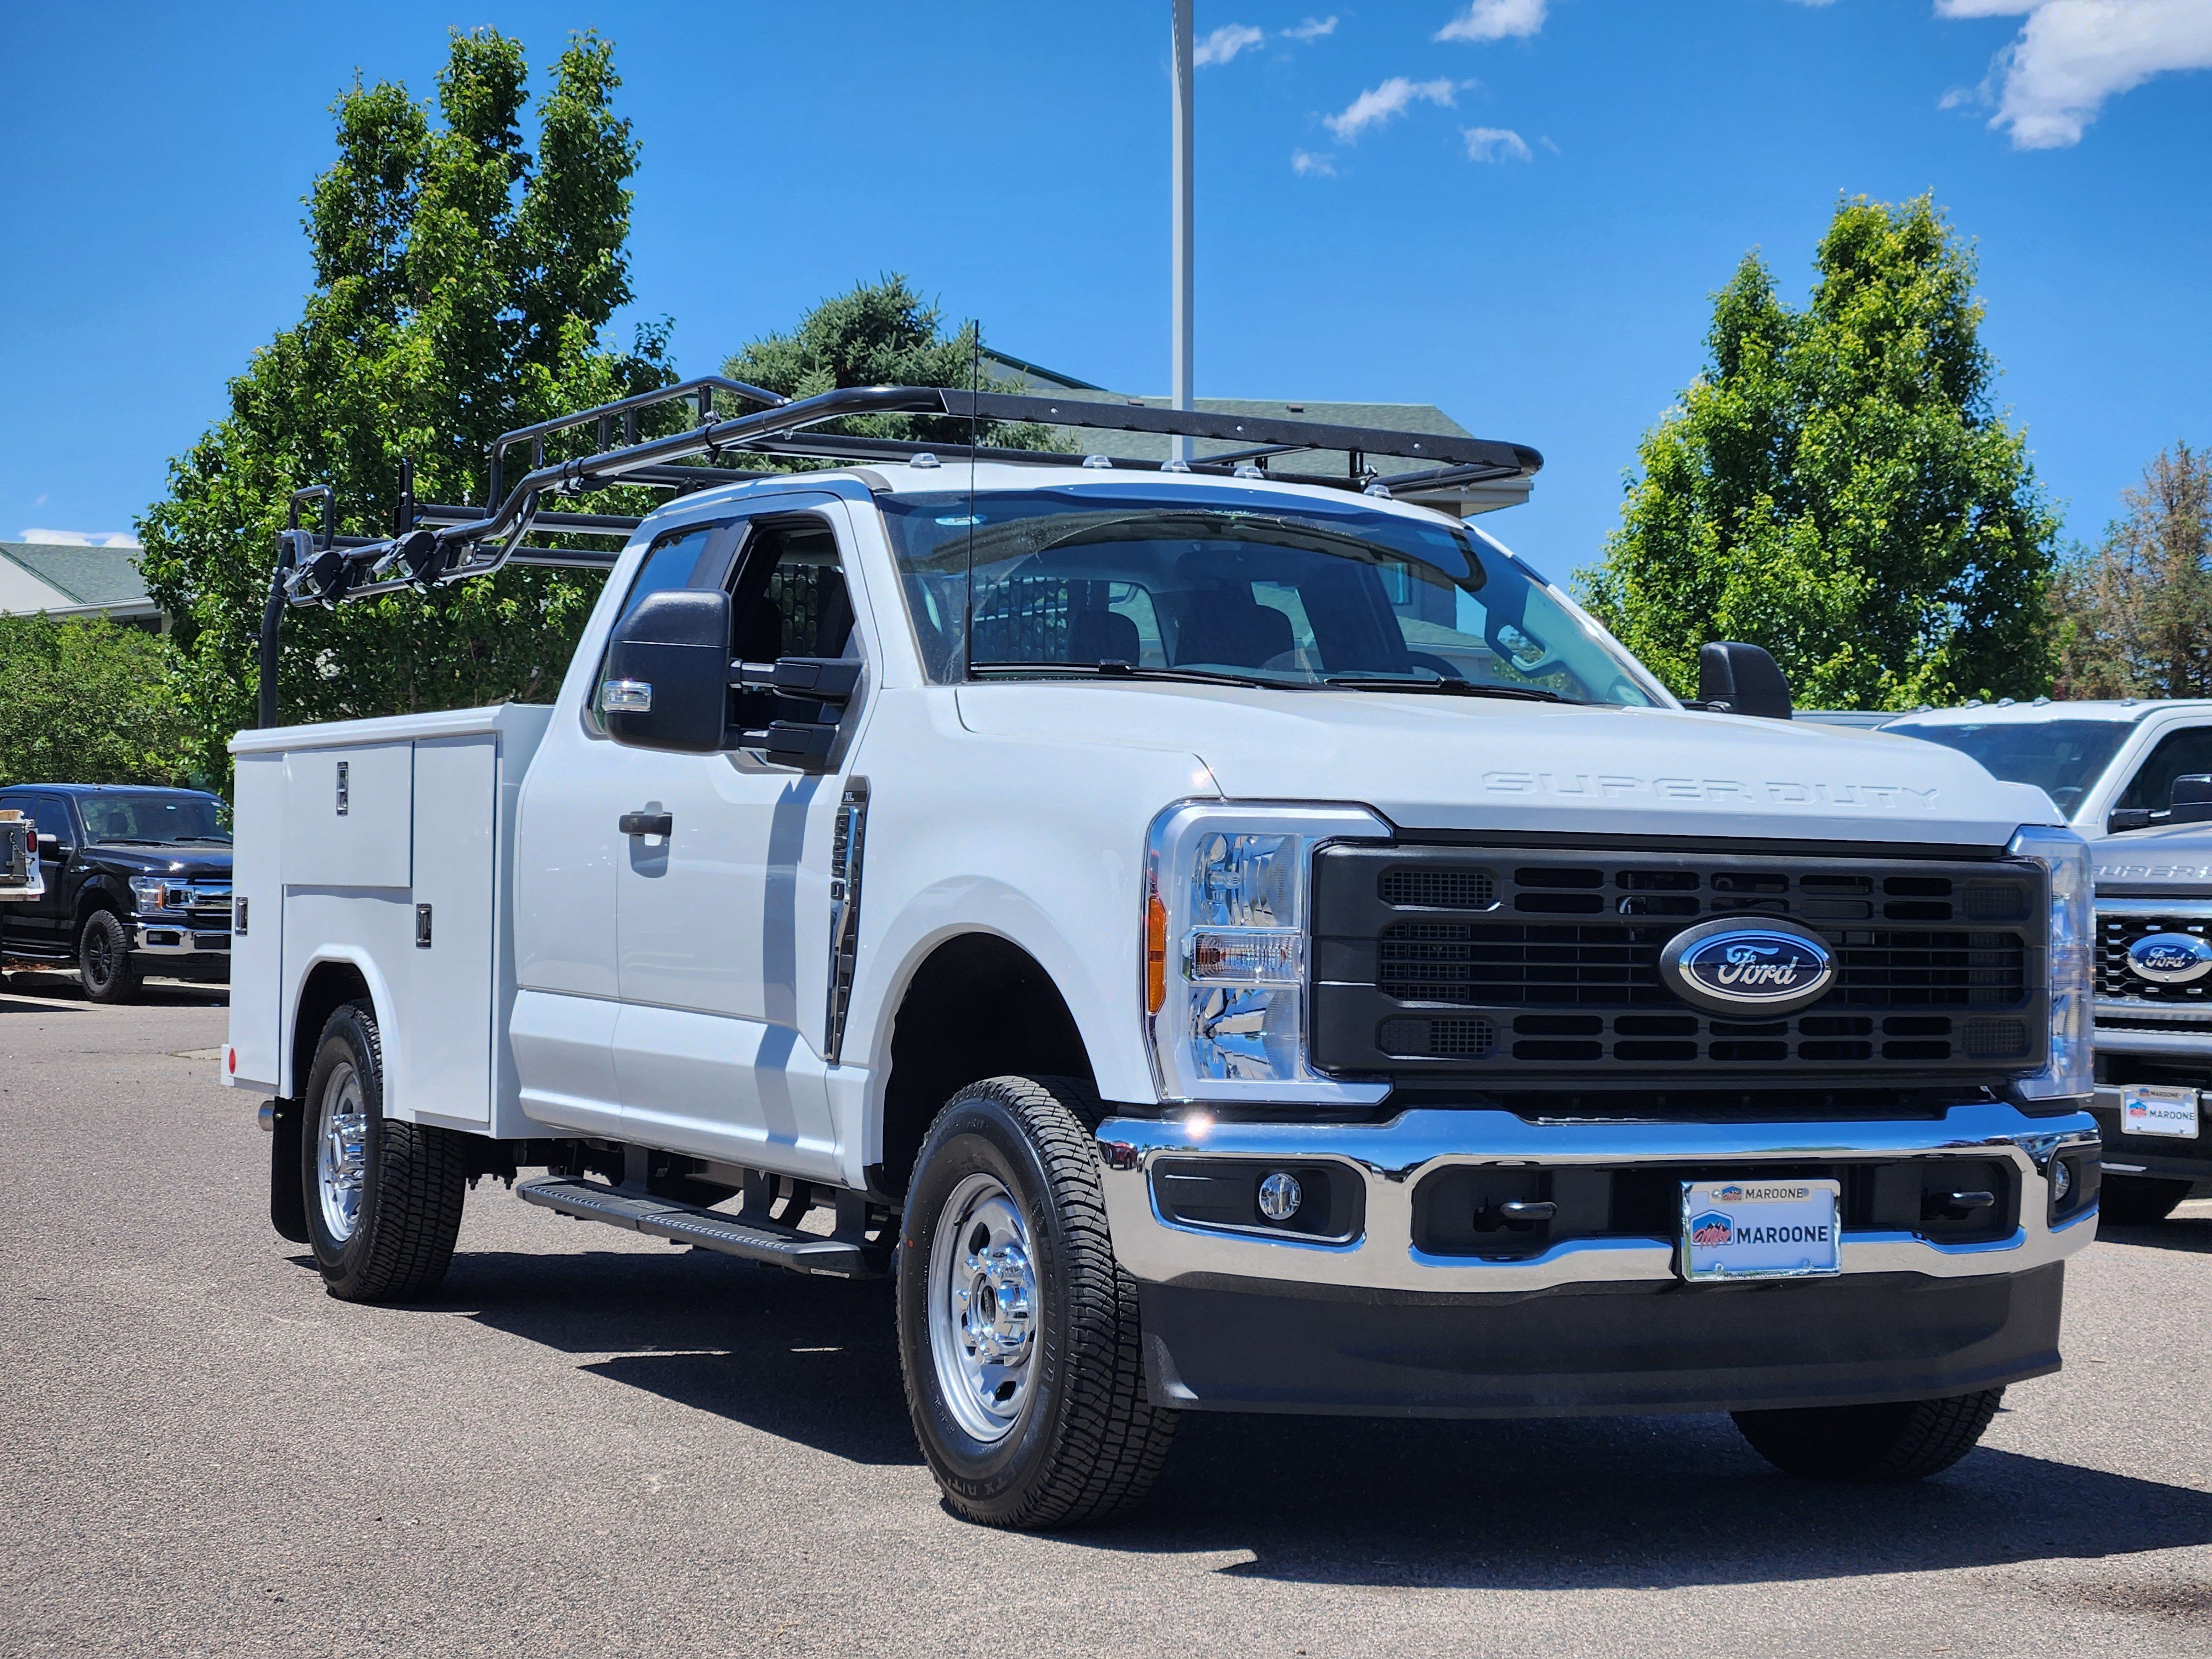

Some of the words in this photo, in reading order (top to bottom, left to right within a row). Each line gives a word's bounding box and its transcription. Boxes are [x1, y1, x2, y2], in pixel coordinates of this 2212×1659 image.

[843, 791, 854, 802] XL
[1482, 771, 1755, 804] SUPER
[1765, 780, 1942, 810] DUTY
[1718, 945, 1799, 985] Ford
[2146, 947, 2187, 968] Ford
[2150, 1109, 2195, 1121] MAROONE
[1745, 1188, 1804, 1199] MAROONE
[1736, 1225, 1828, 1244] MAROONE
